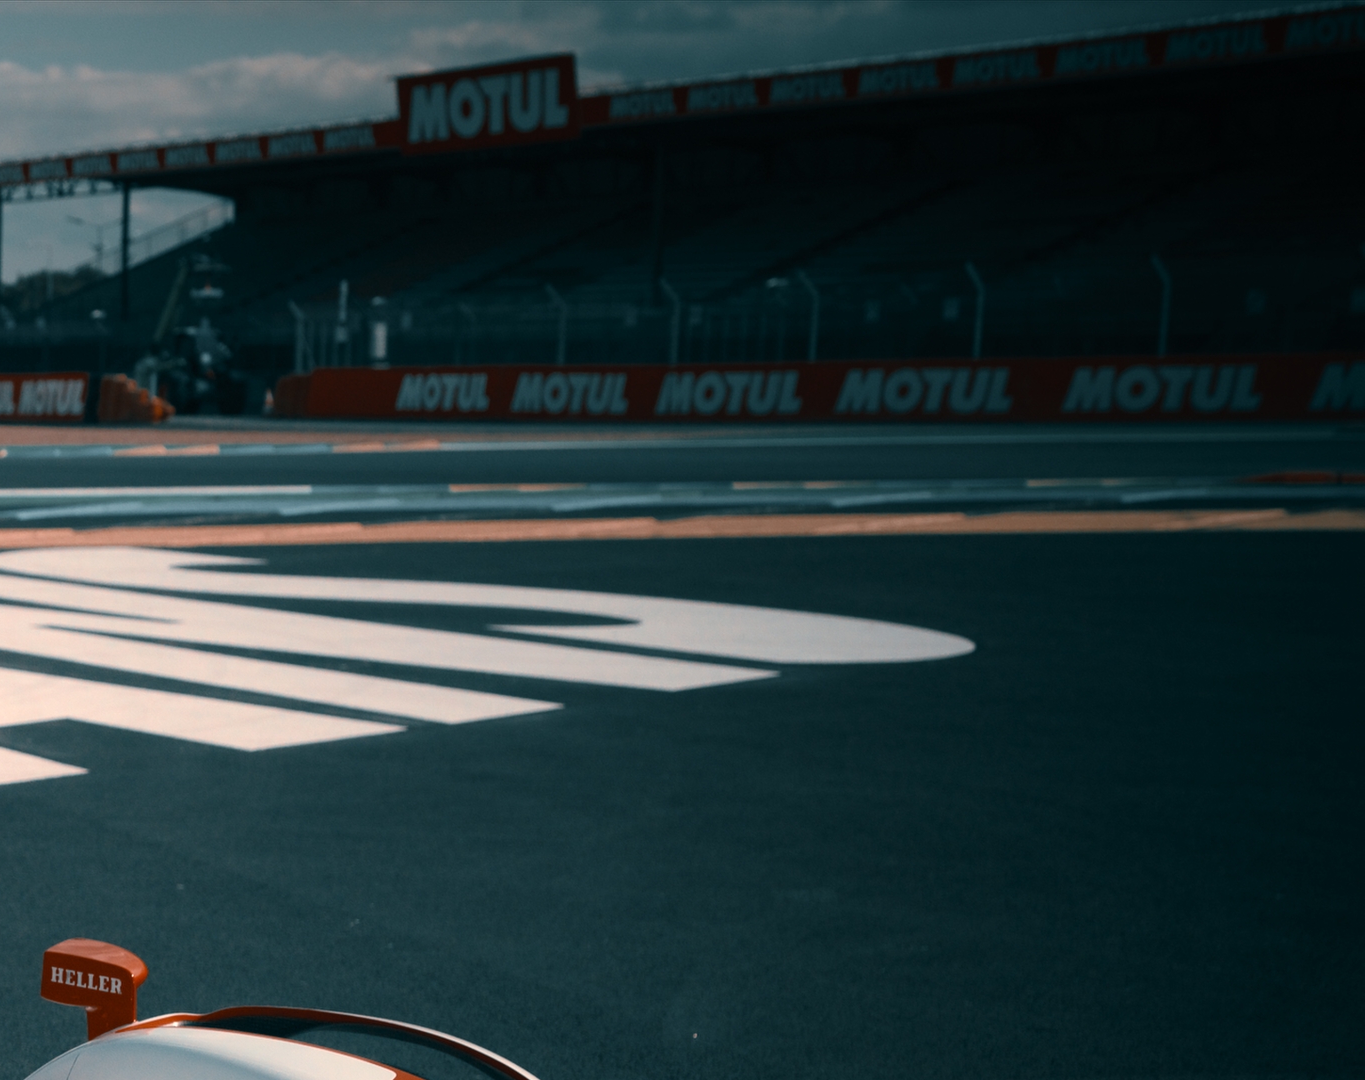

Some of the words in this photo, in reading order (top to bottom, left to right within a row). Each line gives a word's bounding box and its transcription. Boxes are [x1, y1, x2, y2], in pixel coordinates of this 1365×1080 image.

[1055, 38, 1149, 73] MOTUL
[1166, 24, 1268, 61] MOTUL
[1285, 8, 1365, 49] MOTU
[407, 66, 569, 144] MOTUL
[395, 372, 491, 412] MOTUL
[510, 371, 630, 414] MOTUL
[655, 369, 803, 415] MOTUL
[833, 366, 1015, 415] MOTUL
[1061, 363, 1265, 414] MOTUL
[50, 966, 123, 994] HELLER
